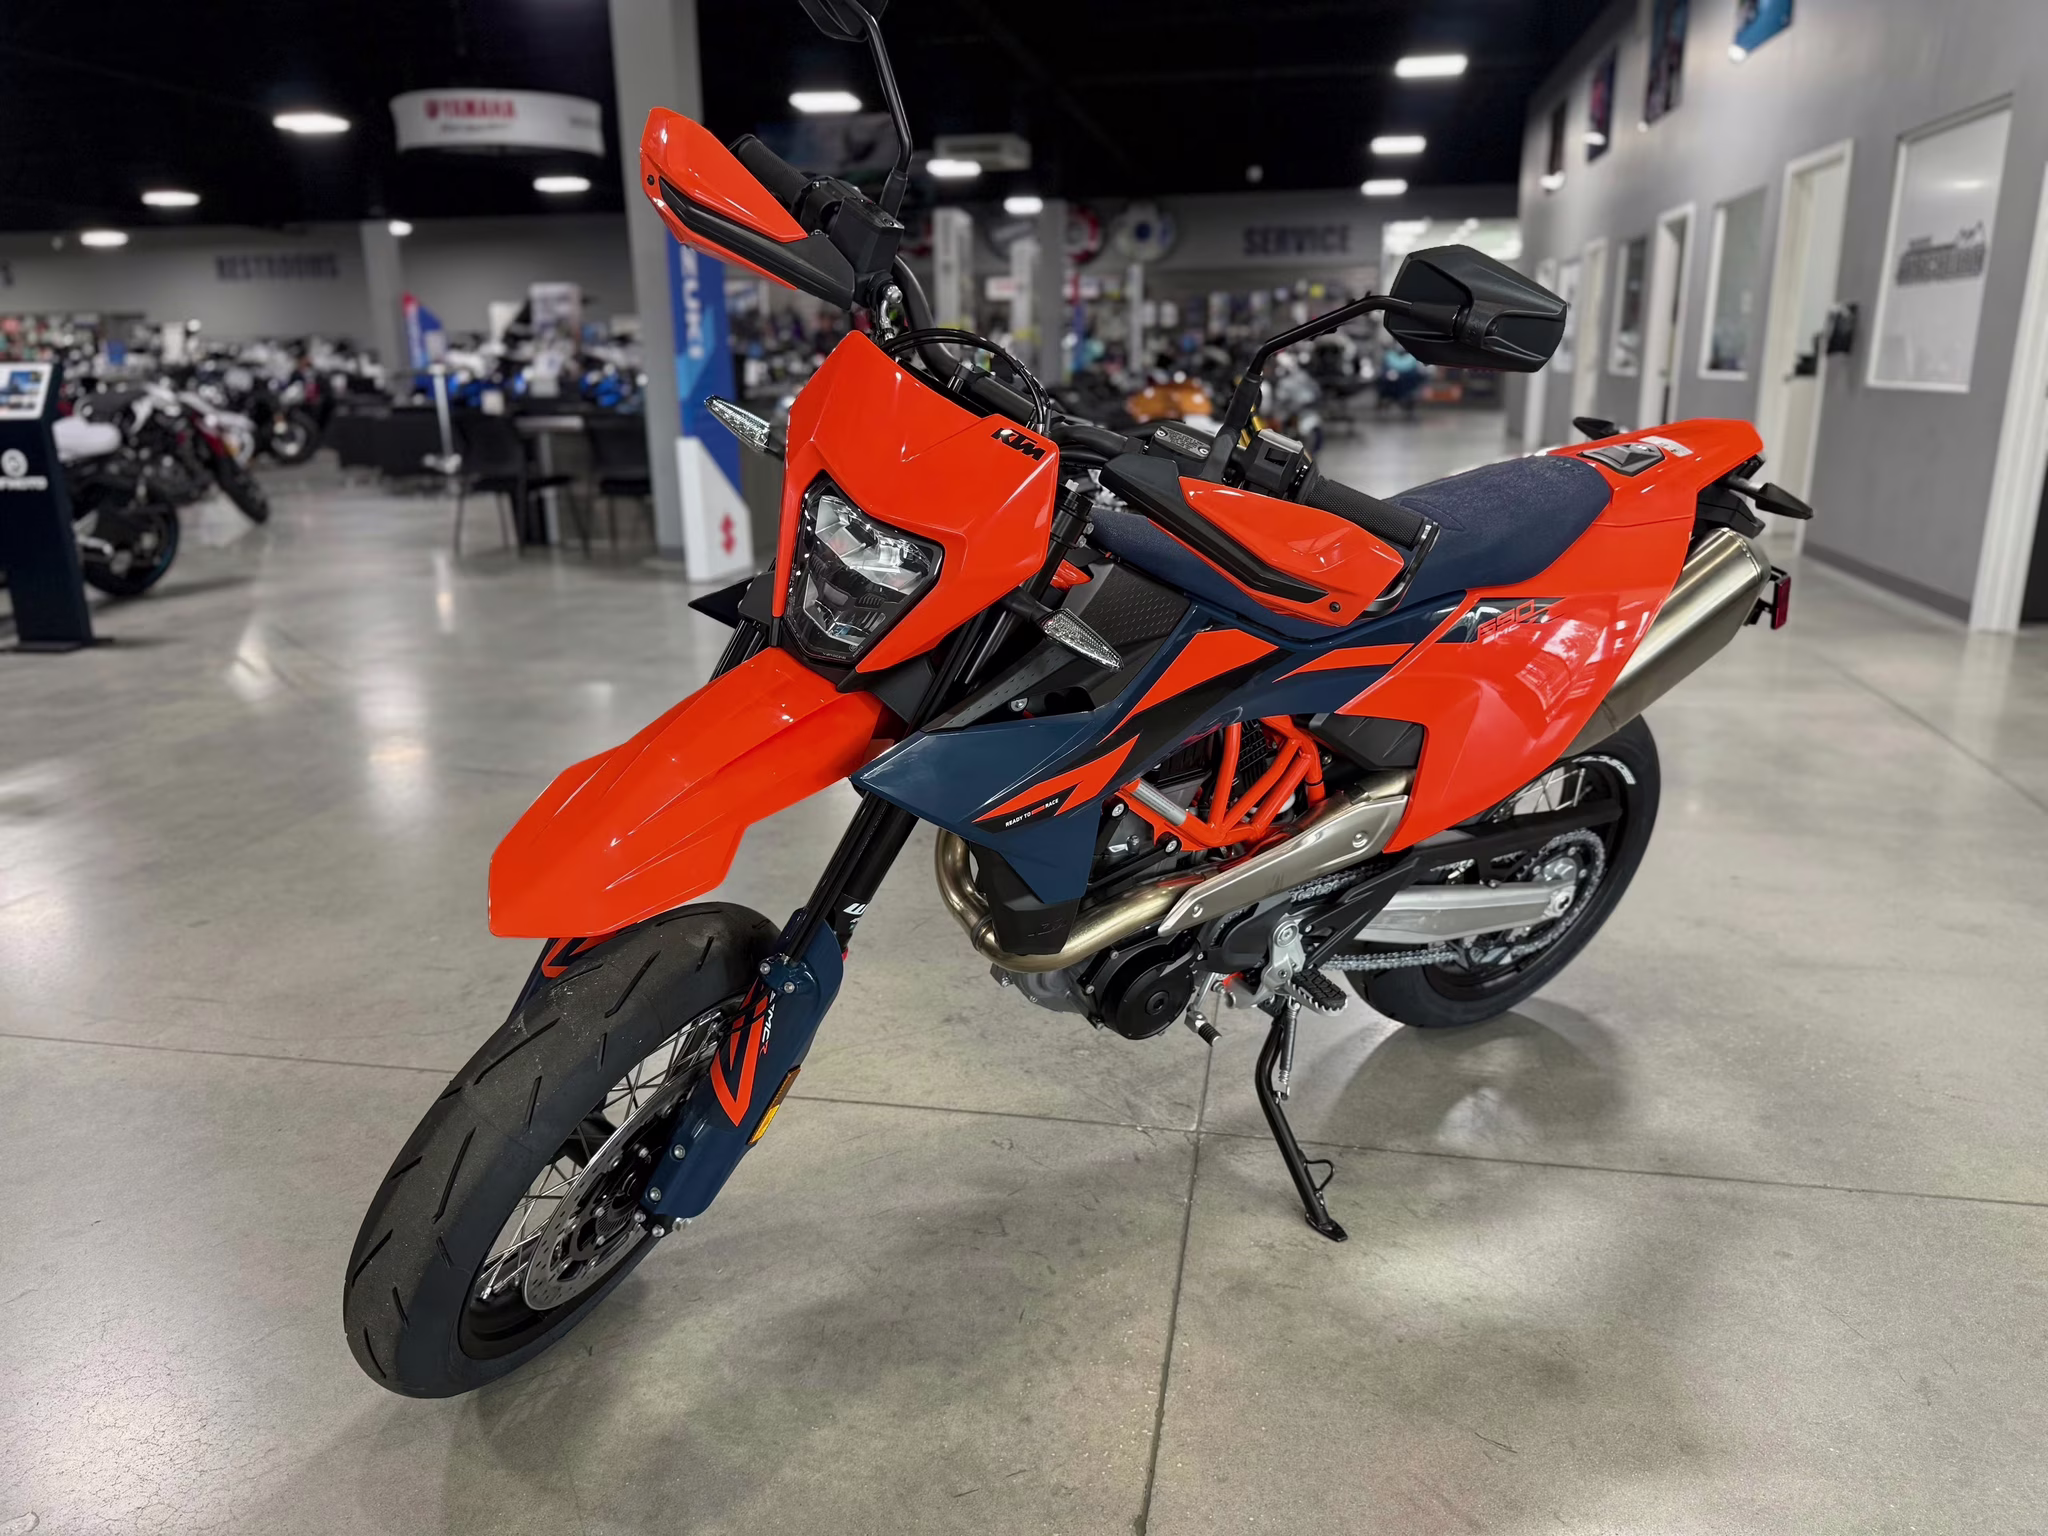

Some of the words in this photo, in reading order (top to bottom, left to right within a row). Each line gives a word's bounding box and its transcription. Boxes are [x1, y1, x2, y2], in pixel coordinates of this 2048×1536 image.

[681, 244, 704, 359] ZUKI
[990, 427, 1046, 461] KTM
[1005, 815, 1024, 828] READY
[1024, 811, 1032, 820] TO
[1045, 798, 1059, 809] RACE
